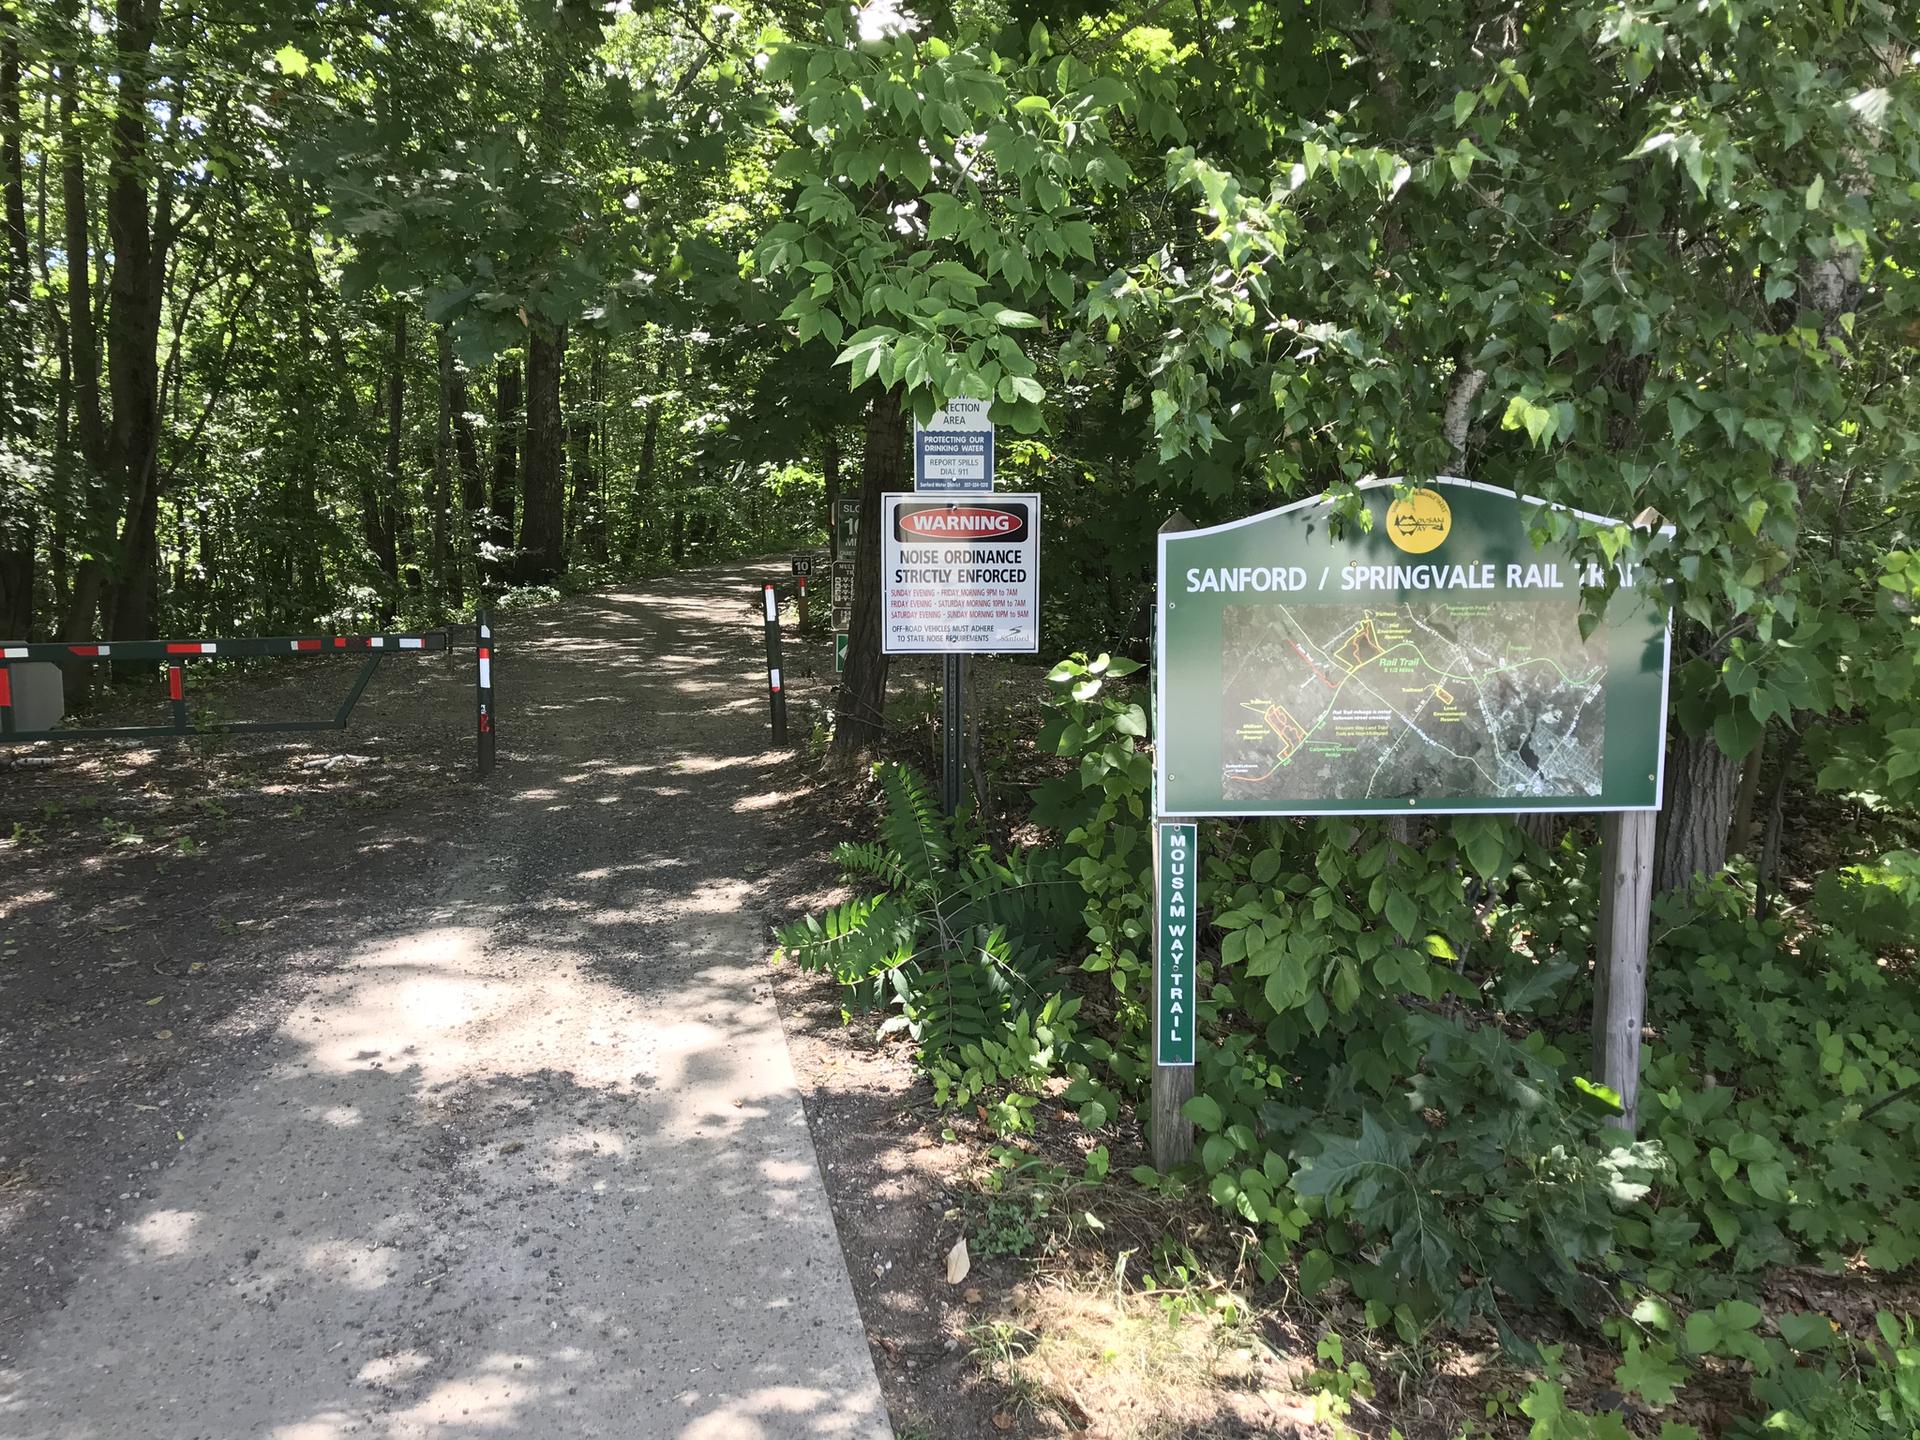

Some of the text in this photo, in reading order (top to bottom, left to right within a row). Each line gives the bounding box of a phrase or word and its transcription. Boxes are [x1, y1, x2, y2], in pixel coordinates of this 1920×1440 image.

[943, 416, 966, 425] AREA
[913, 516, 1009, 530] WARNING
[900, 550, 1022, 564] NOISE ORDINANCE
[795, 561, 808, 571] 10
[895, 569, 1026, 583] STRICTLY ENFORCED
[1186, 567, 1308, 592] SANFORD
[1318, 566, 1330, 591] /
[1341, 564, 1496, 591] SPRINGVALE
[1506, 564, 1564, 588] RAIL
[890, 588, 911, 597] SUNDAY
[913, 588, 935, 597] EVENING
[941, 588, 958, 597] FRIDAY
[959, 588, 984, 596] MORNING
[1006, 588, 1018, 596] 7AM
[890, 600, 908, 608] FRIDAY
[910, 600, 932, 608] EVENING
[938, 600, 964, 608] SATURDAY
[966, 600, 991, 608] MORNING
[1014, 599, 1026, 607] 7AM
[891, 611, 918, 619] SATURDAY
[919, 610, 941, 618] EVENING
[947, 610, 968, 618] SUNDAY
[969, 610, 994, 618] MORNING
[1379, 658, 1420, 666] Rail Trail
[1168, 835, 1186, 1042] MOUSAM WAY TRAIL
